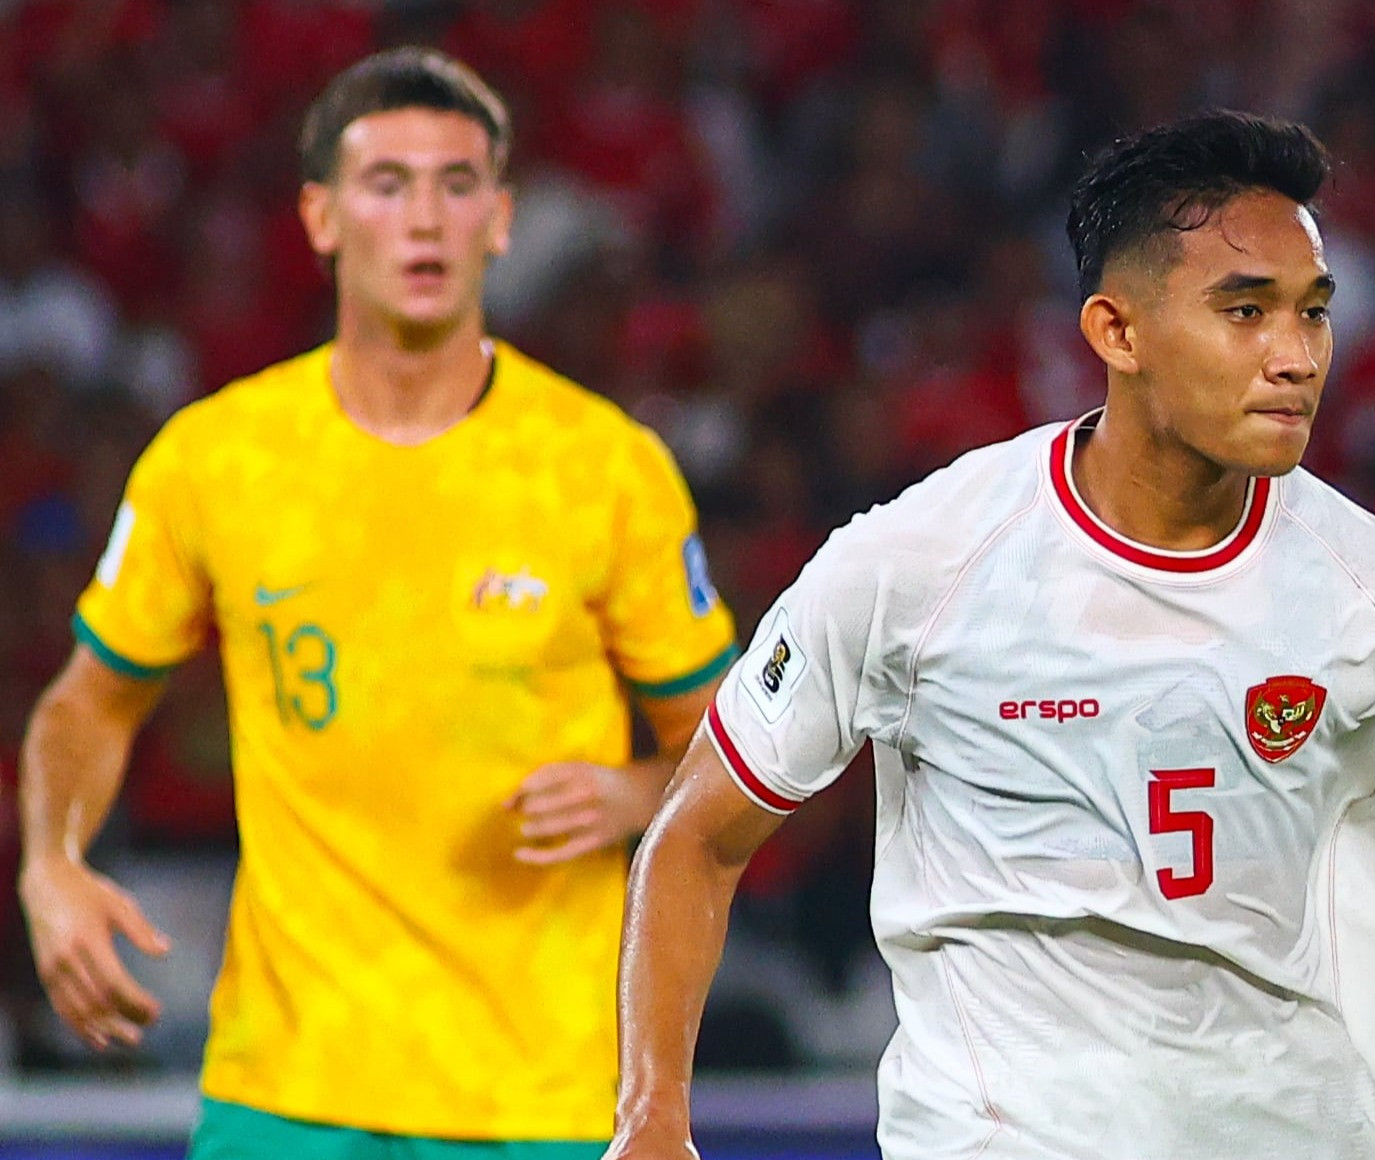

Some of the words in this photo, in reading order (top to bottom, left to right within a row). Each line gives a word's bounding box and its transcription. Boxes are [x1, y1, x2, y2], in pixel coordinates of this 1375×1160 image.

[259, 620, 339, 731] 13
[999, 698, 1100, 721] erspo
[1148, 767, 1216, 901] 5
